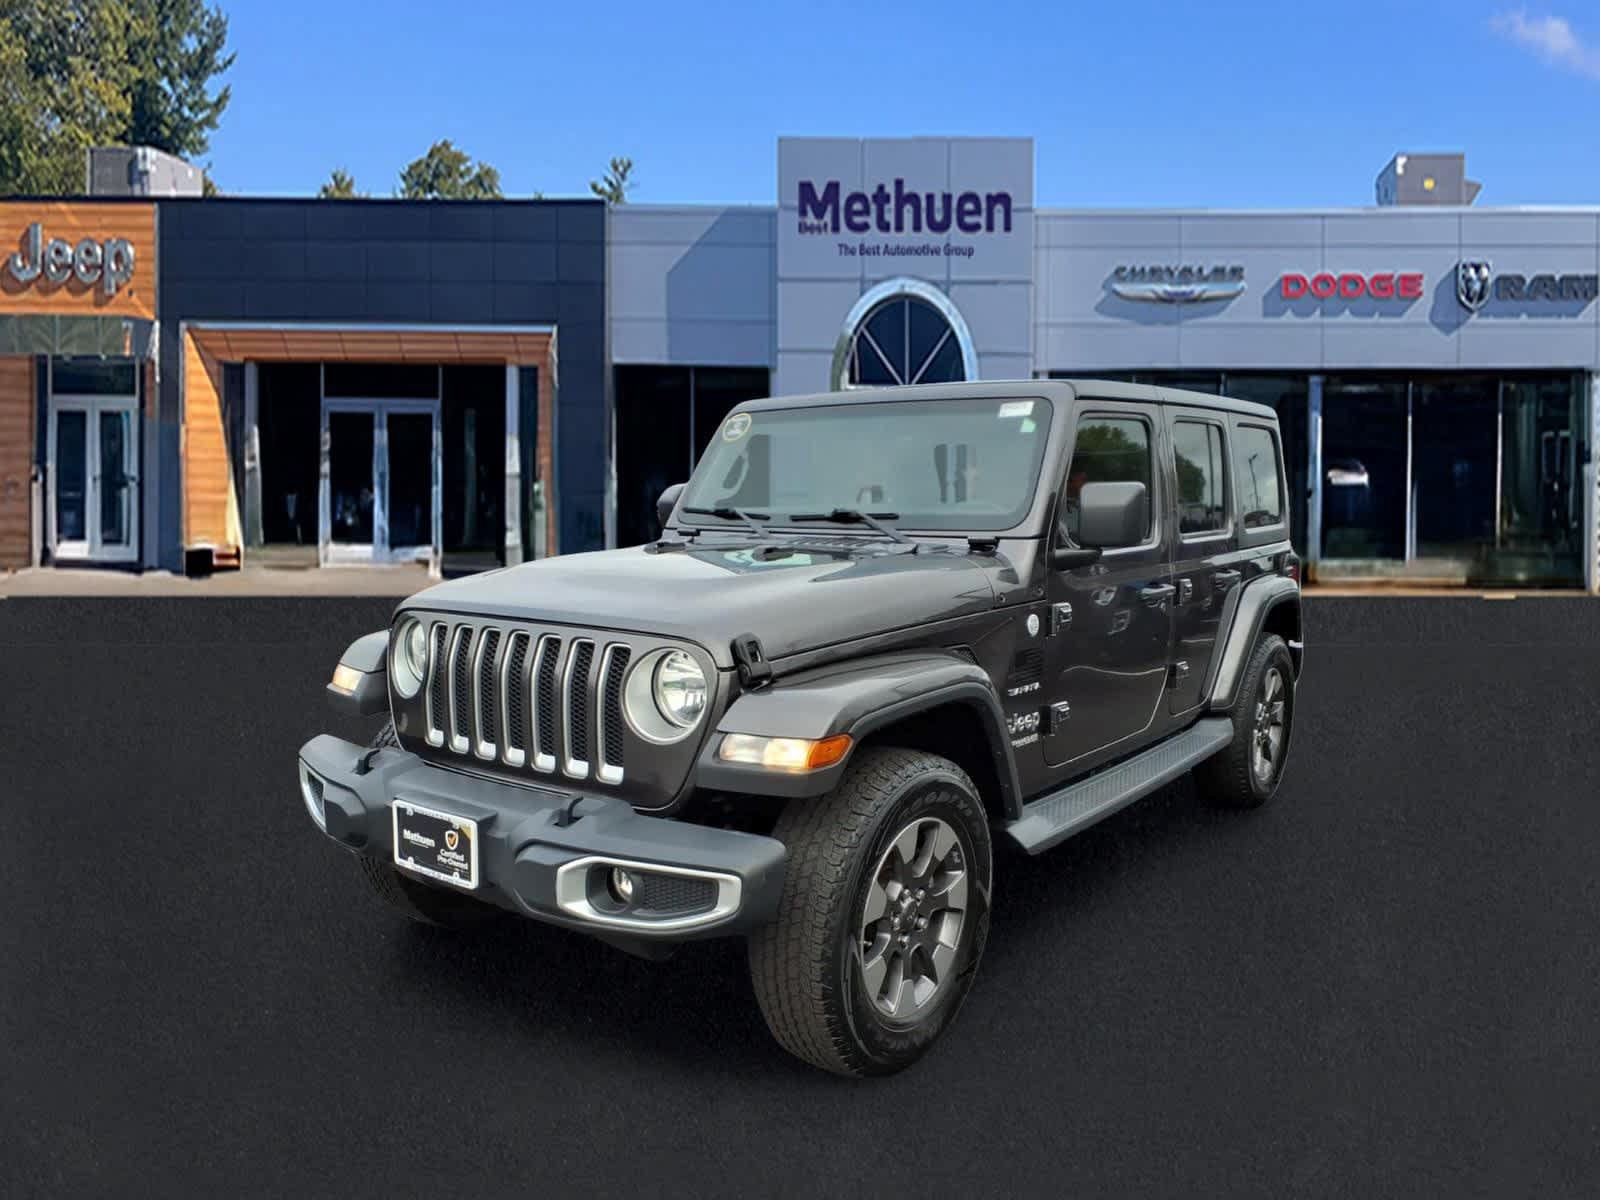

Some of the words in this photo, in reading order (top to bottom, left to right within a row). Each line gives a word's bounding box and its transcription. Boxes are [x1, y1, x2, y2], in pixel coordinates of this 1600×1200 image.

[798, 178, 1012, 233] Methuen
[9, 222, 135, 296] Jeep
[837, 243, 857, 257] The
[859, 243, 880, 257] Best
[882, 243, 941, 257] Automotive
[943, 243, 975, 259] Group
[1113, 265, 1244, 281] CHRYSLER
[1281, 273, 1424, 298] DODGE
[1495, 273, 1599, 300] RAM
[1007, 711, 1041, 734] Jeep
